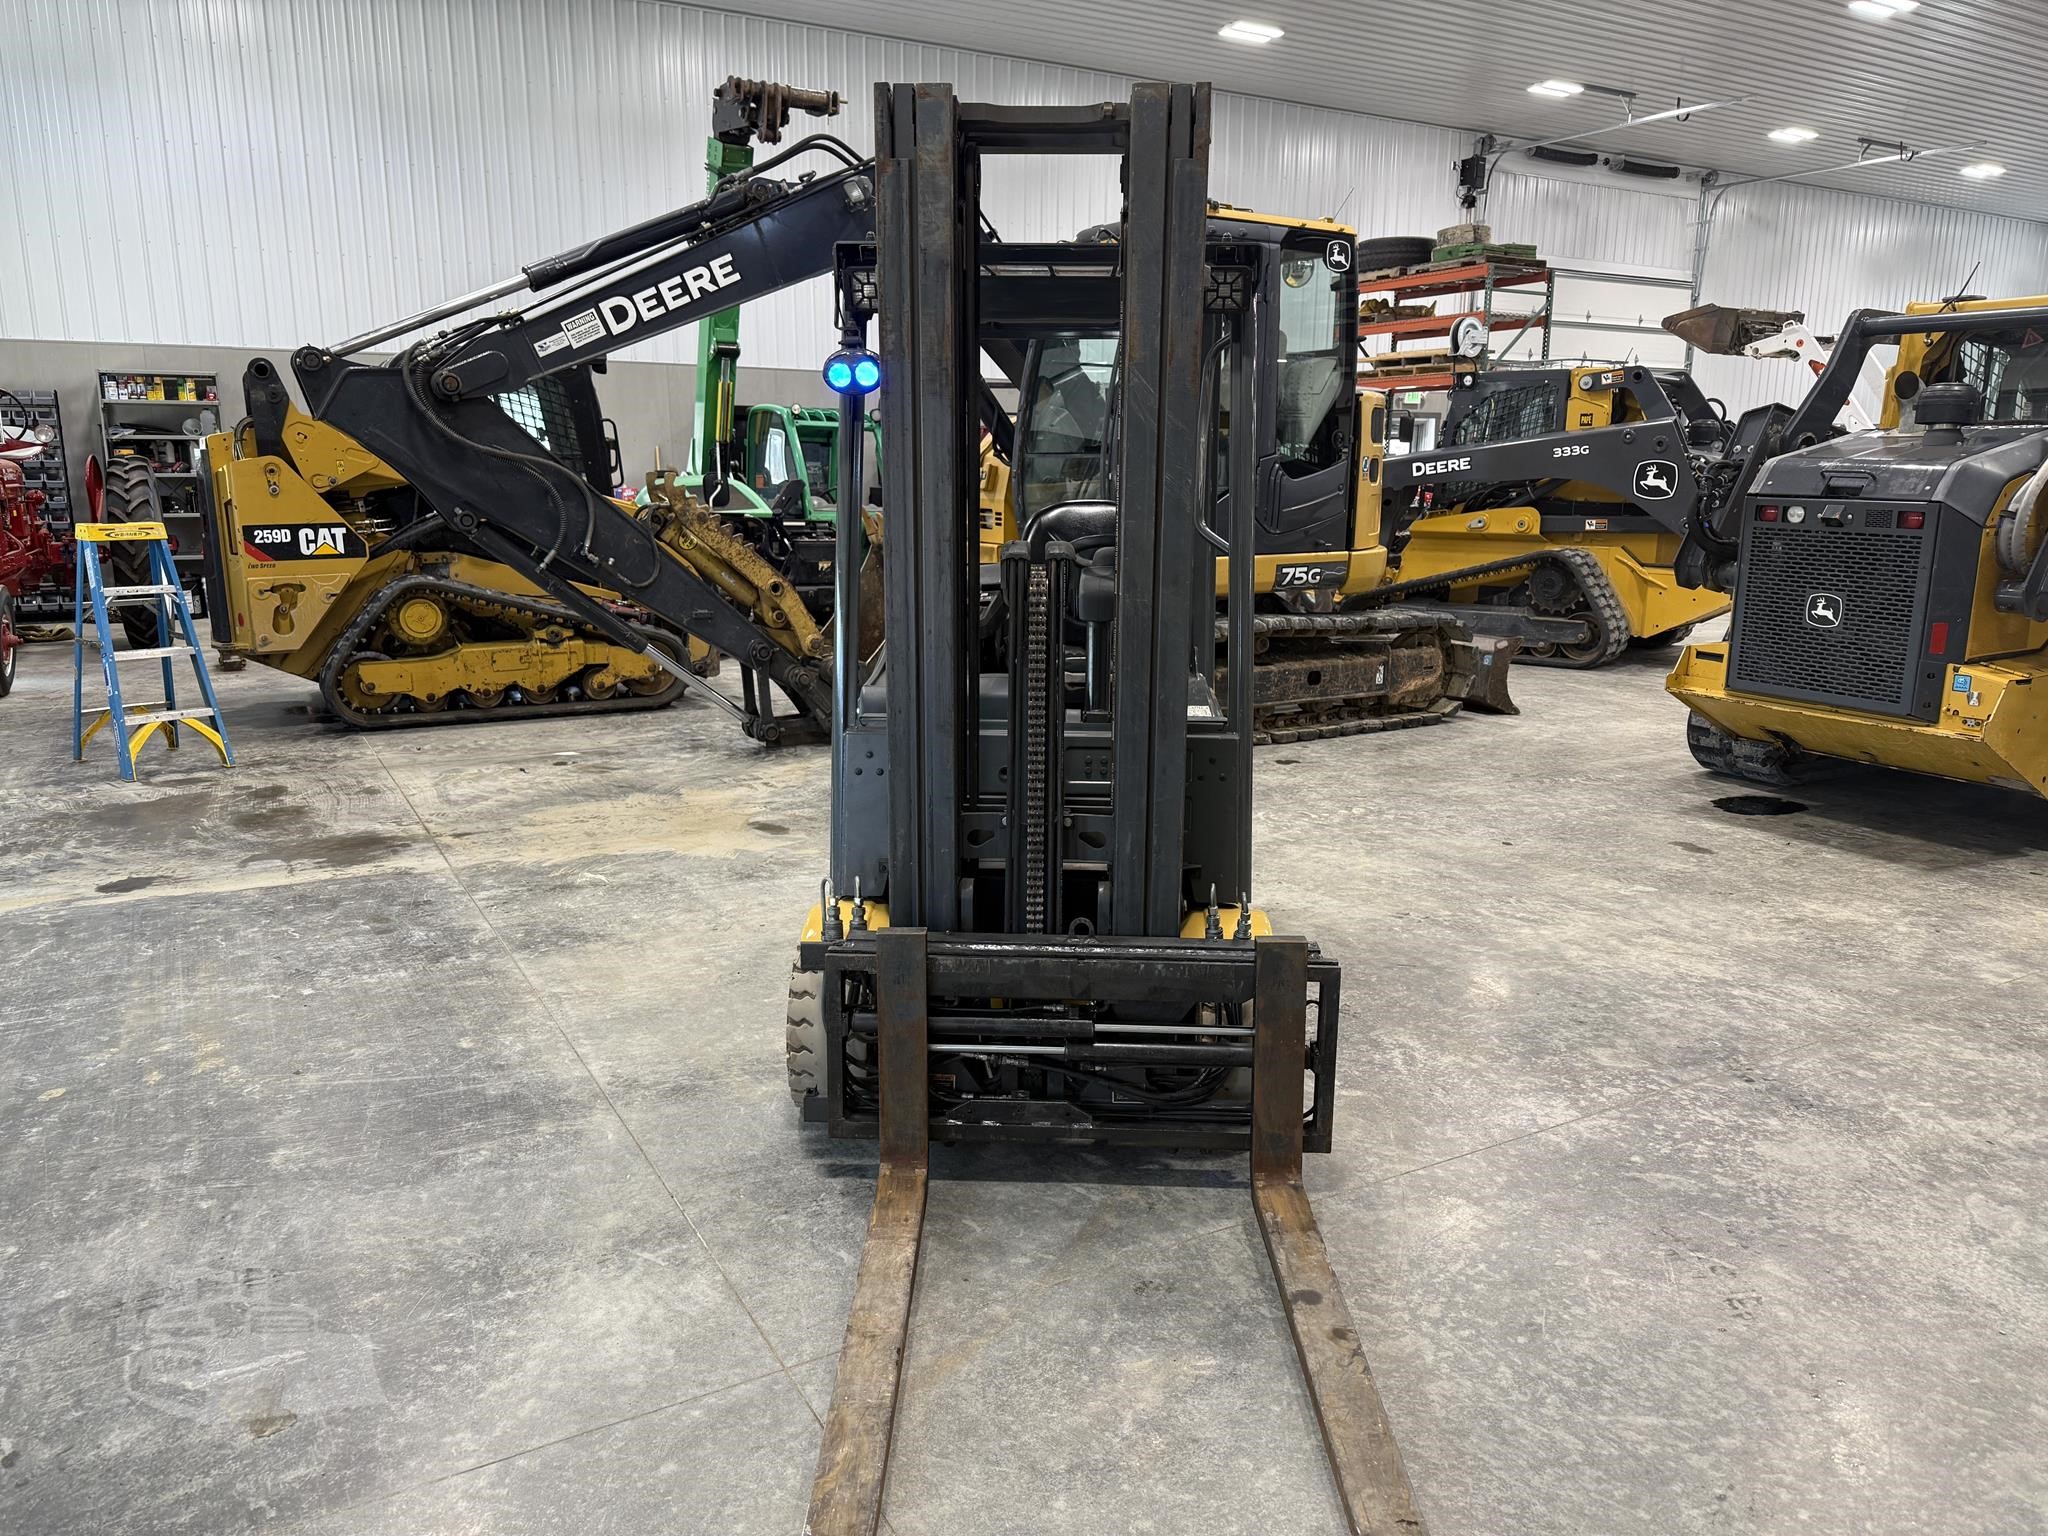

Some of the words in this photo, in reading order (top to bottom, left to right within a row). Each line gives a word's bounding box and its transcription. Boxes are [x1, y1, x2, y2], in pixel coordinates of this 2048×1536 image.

[598, 253, 741, 336] DEERE
[565, 312, 596, 331] WARNING
[1552, 445, 1590, 458] 333G
[1412, 457, 1471, 477] DEERE
[253, 528, 292, 544] 259D
[298, 527, 347, 556] CAT
[1281, 566, 1321, 586] 75G
